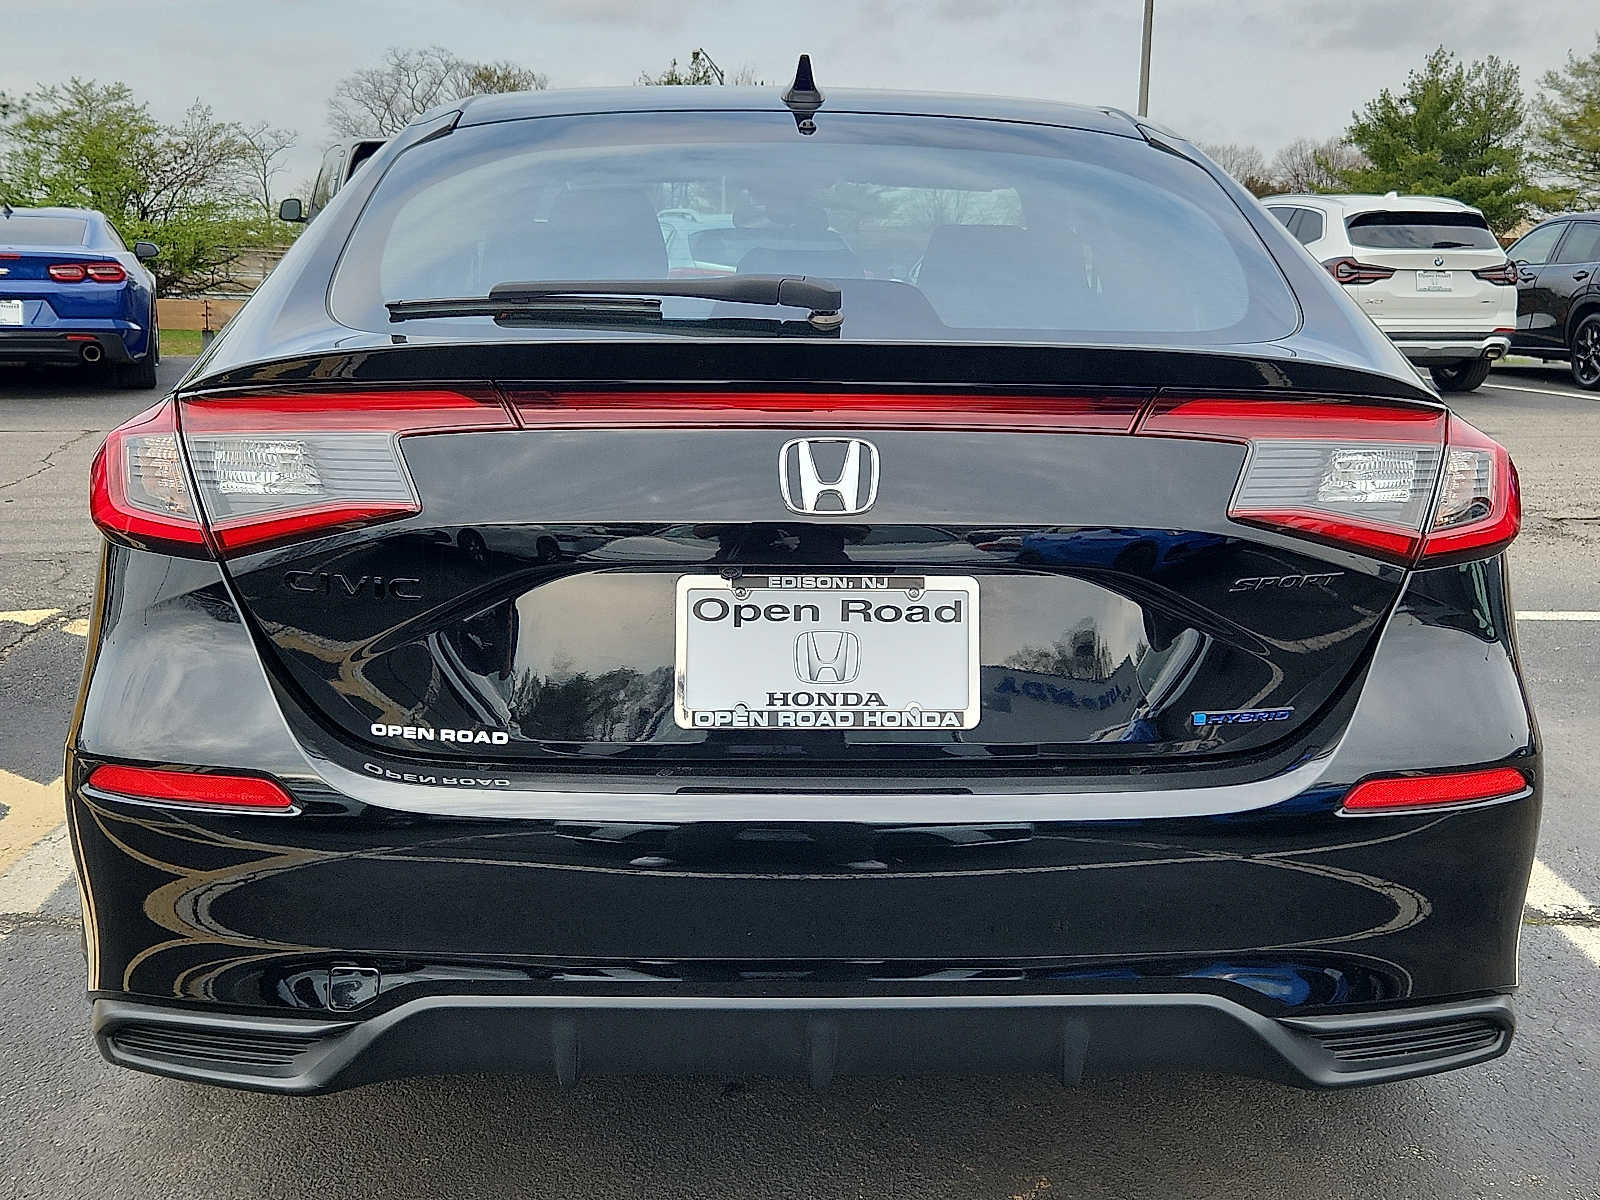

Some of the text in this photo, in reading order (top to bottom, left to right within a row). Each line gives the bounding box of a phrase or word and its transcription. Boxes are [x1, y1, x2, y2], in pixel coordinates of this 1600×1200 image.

[284, 570, 425, 600] CIVIC
[768, 576, 888, 589] EDISON, NJ
[1229, 572, 1344, 593] SPORT
[692, 597, 962, 627] Open Road
[765, 692, 888, 707] HONDA
[694, 711, 961, 727] OPEN ROAD HONDA
[1207, 710, 1291, 724] HYBRID
[370, 723, 509, 745] OPEN ROAD
